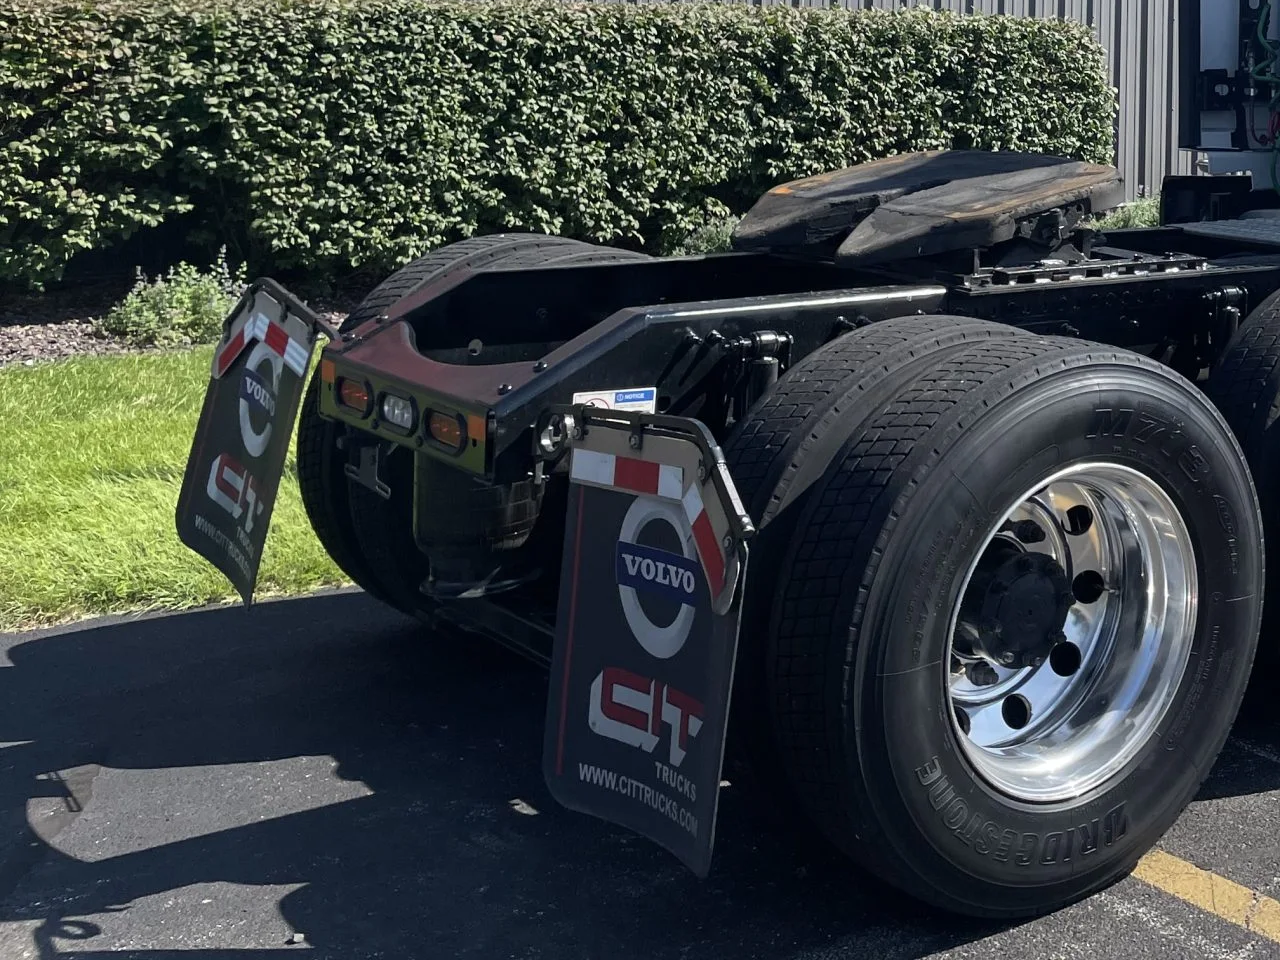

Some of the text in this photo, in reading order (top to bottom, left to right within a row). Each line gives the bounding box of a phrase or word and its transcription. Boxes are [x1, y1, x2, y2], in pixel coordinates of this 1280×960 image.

[621, 553, 695, 594] VOLVO
[588, 667, 705, 768] CIT
[579, 762, 699, 838] WWW.CITTRUCKS.COM
[655, 761, 697, 803] TRUCKS
[914, 755, 1130, 867] BRIDGESTONE
